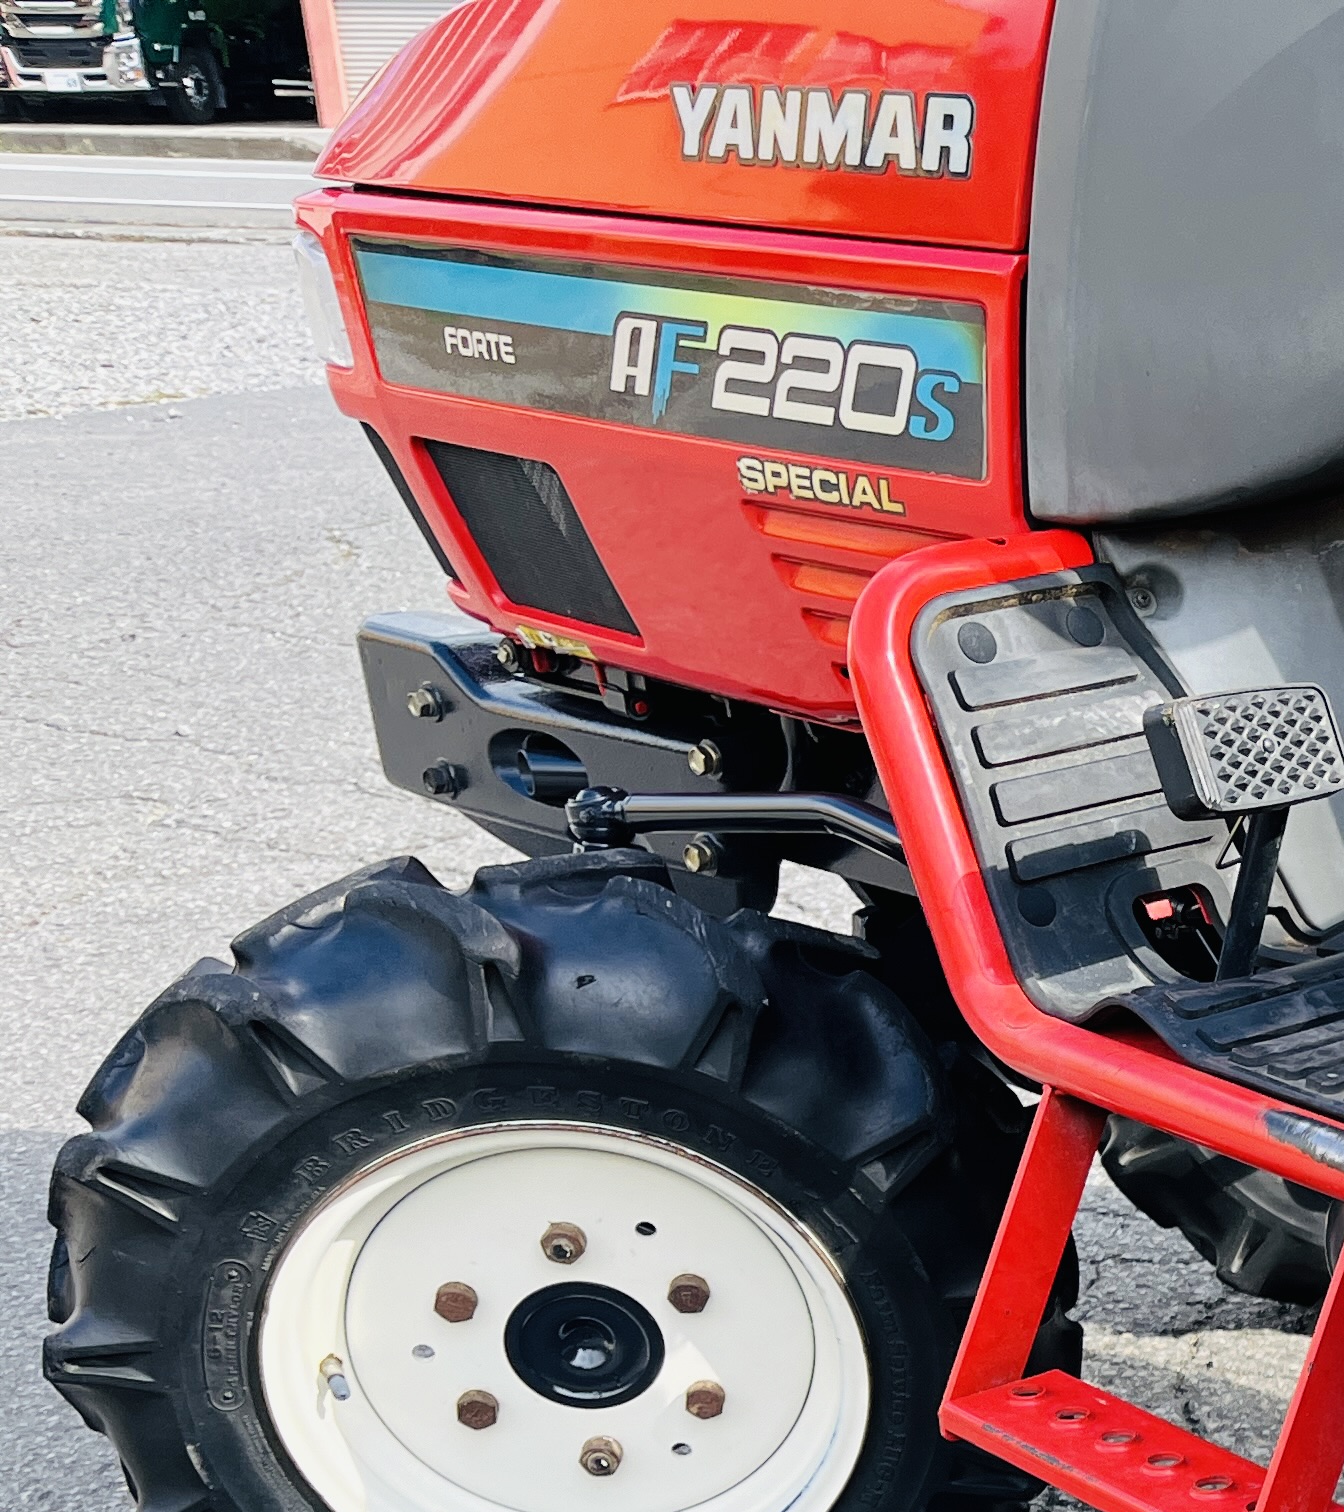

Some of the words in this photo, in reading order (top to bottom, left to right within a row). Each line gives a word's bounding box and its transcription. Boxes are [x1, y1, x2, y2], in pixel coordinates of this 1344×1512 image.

[672, 84, 976, 178] YANMAR
[443, 326, 516, 365] FORTE
[737, 457, 906, 515] SPECIAL
[296, 1085, 778, 1186] BRIDGESTONE
